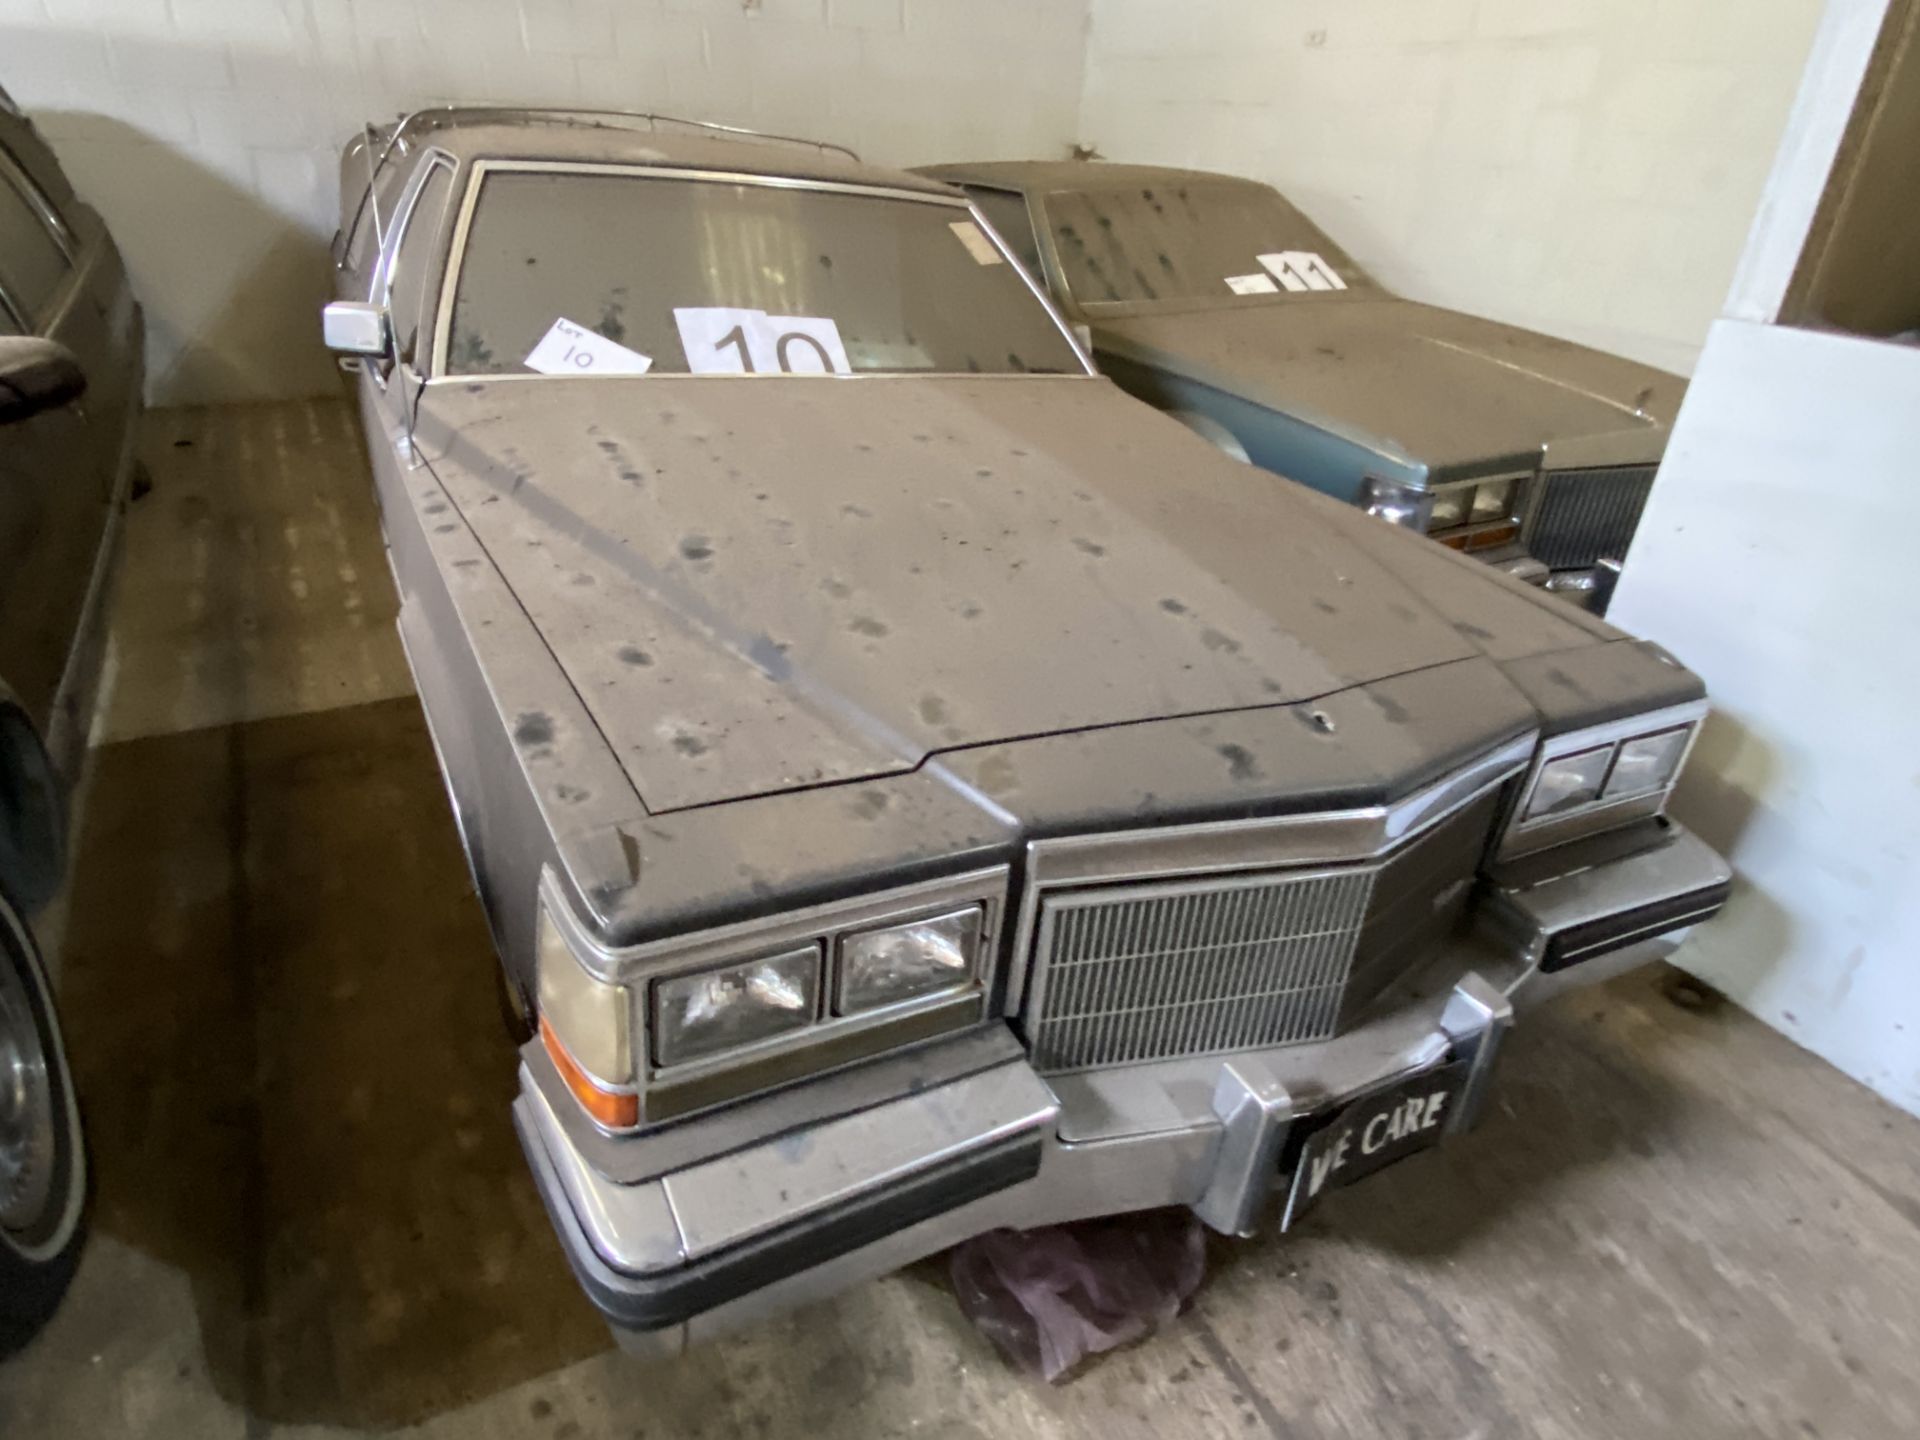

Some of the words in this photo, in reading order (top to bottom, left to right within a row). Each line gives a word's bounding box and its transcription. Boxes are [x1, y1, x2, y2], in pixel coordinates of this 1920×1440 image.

[1282, 261, 1337, 290] 11
[563, 345, 593, 368] 10
[714, 325, 836, 373] 10
[1361, 1090, 1448, 1155] CARE
